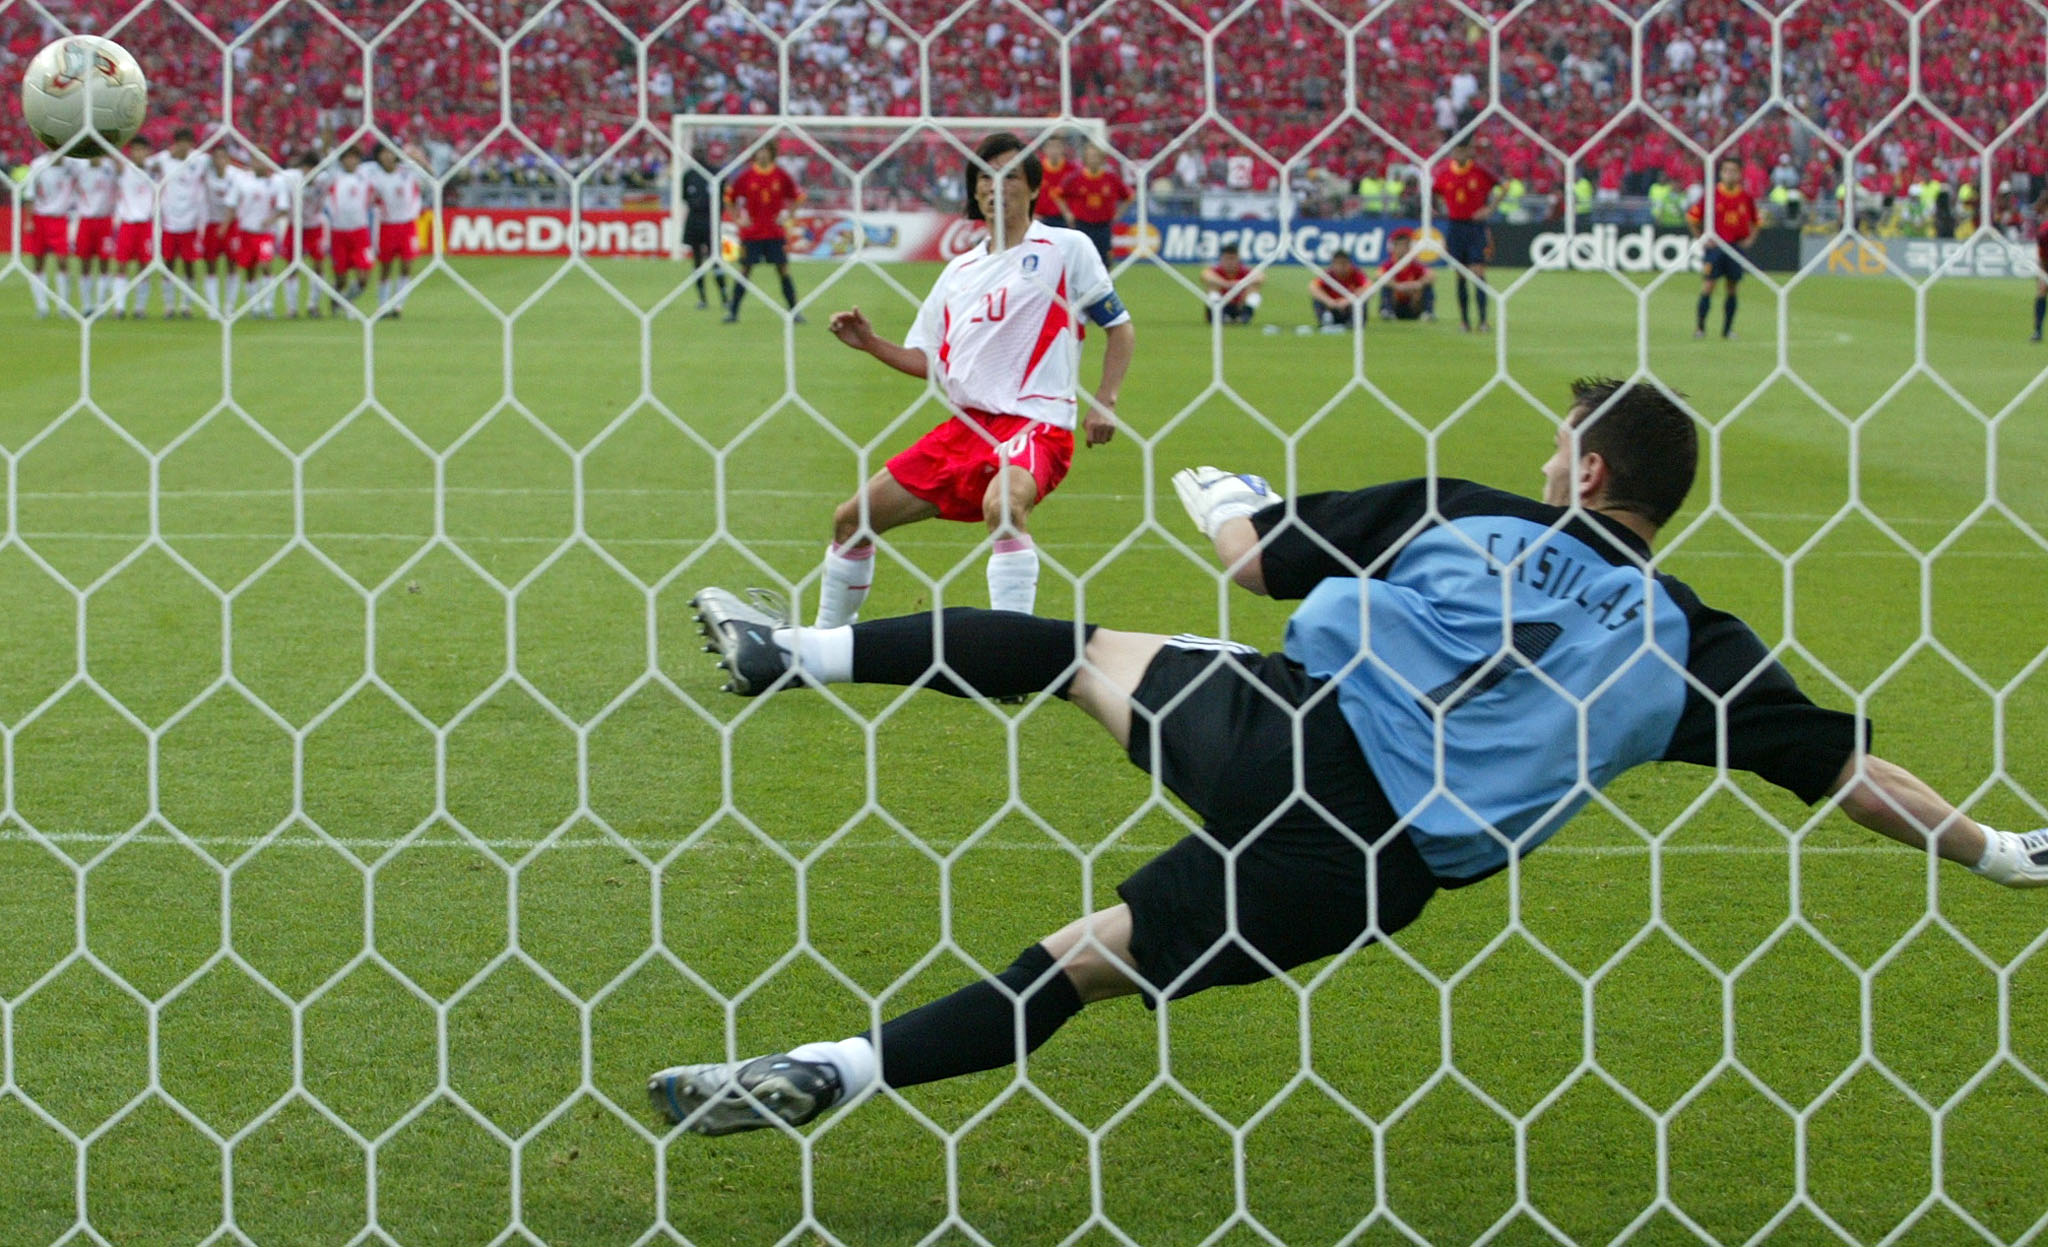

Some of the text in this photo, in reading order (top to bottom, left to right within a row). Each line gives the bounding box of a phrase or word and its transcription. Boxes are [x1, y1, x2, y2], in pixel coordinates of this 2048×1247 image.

[450, 214, 676, 251] McDonal
[1163, 222, 1385, 263] MasterCard
[1828, 241, 1887, 274] KB
[1486, 532, 1648, 631] CASILLAS
